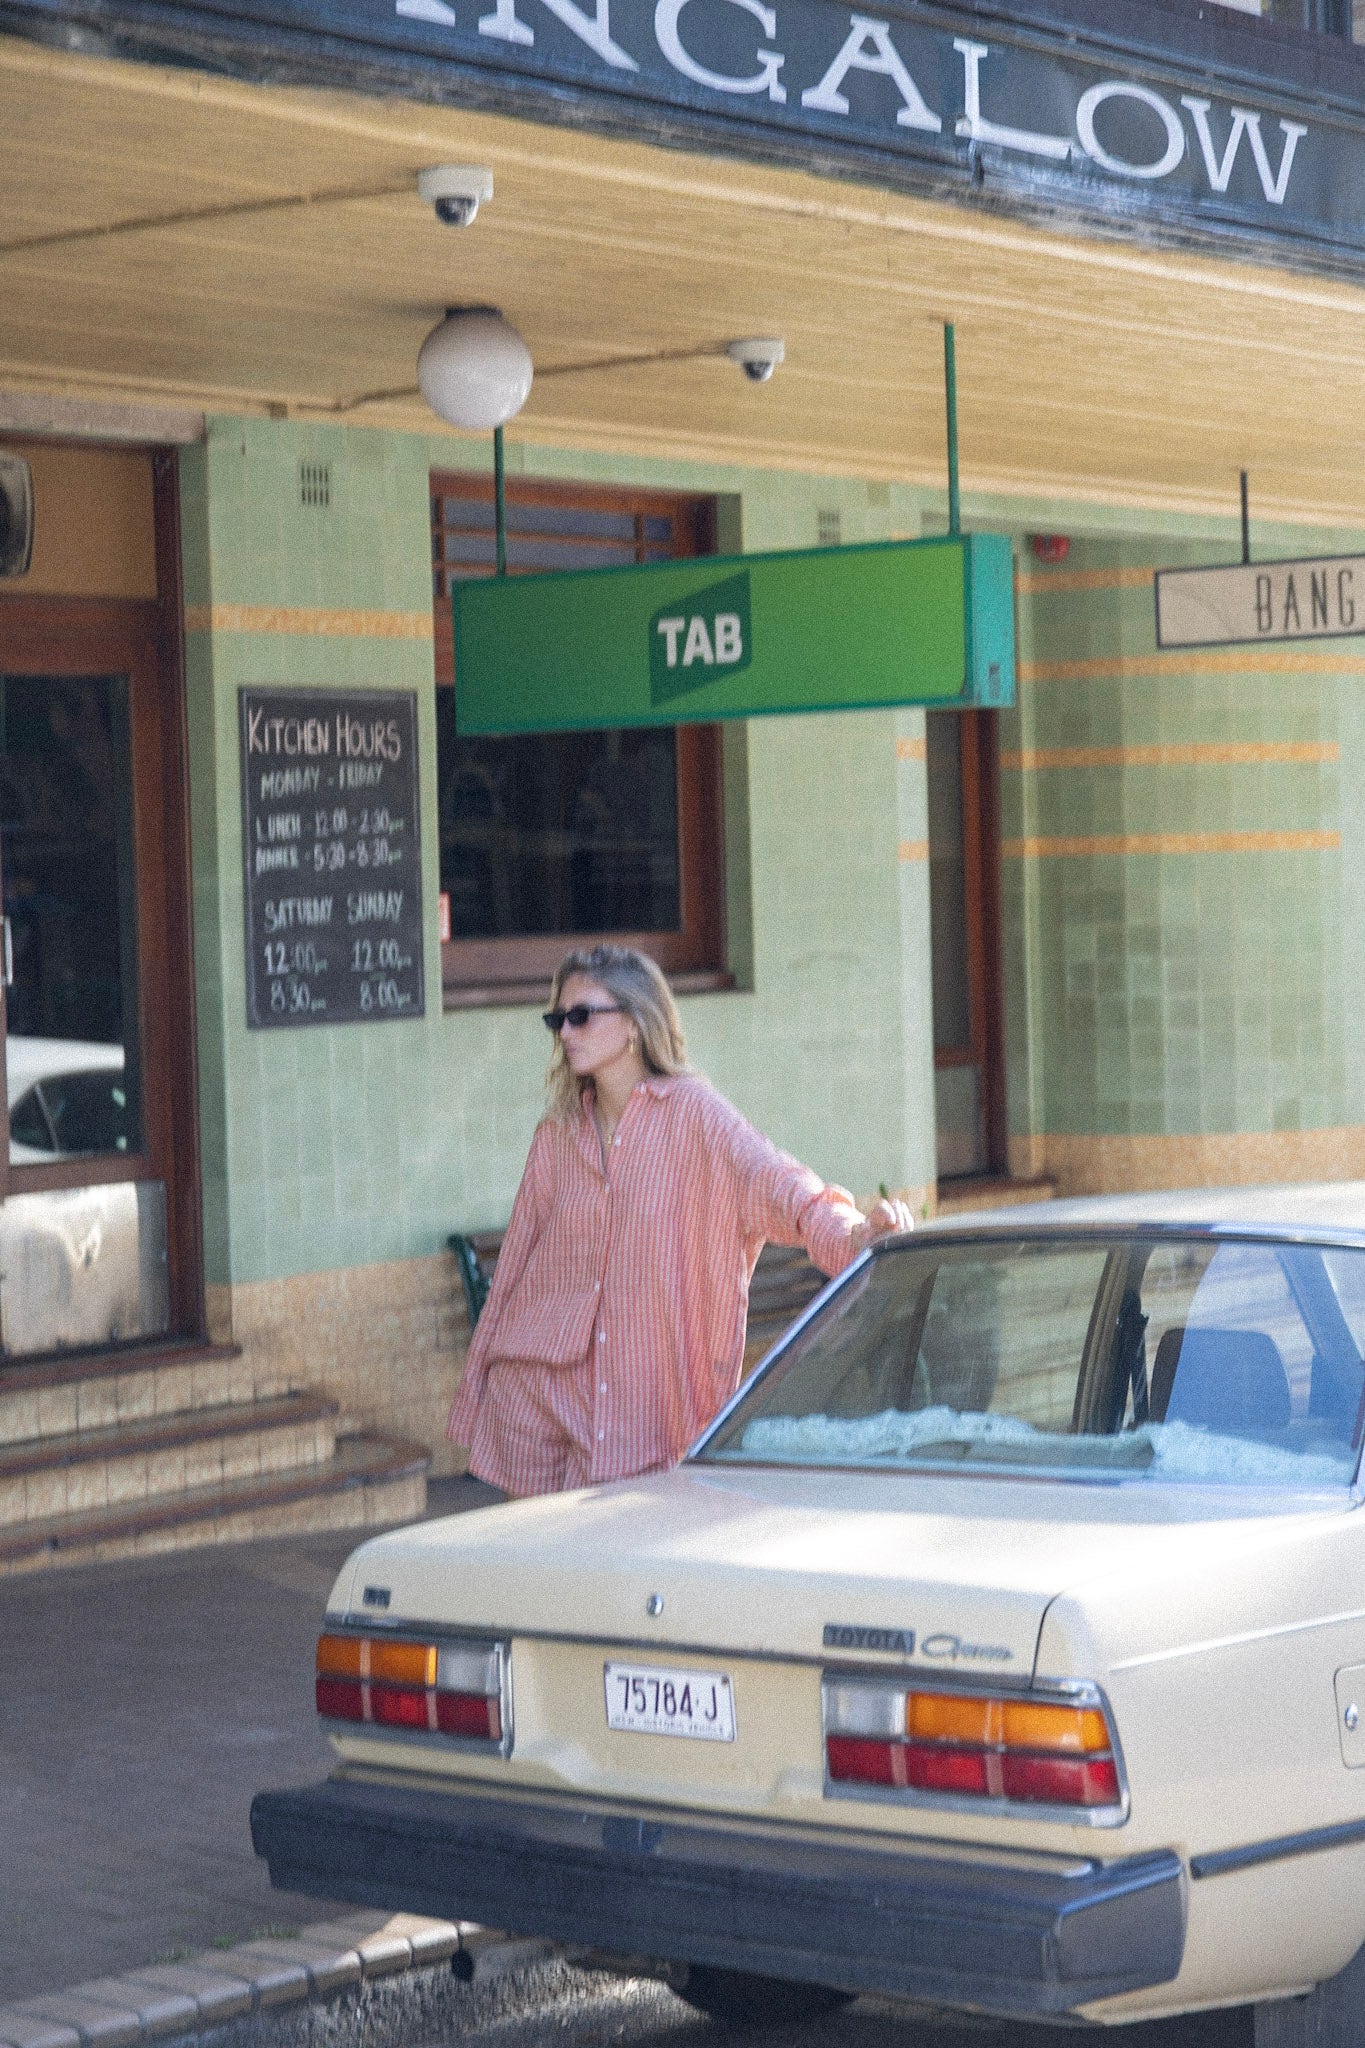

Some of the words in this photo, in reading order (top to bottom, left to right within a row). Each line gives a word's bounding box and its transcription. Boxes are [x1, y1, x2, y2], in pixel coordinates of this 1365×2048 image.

[395, 0, 1309, 204] NGALOW
[1255, 568, 1356, 633] BANG
[657, 612, 743, 668] TAB
[248, 705, 329, 755] KITCHEN
[336, 711, 401, 763] HOURS
[261, 765, 320, 800] MONDAY
[338, 760, 383, 791] FRIDAY
[347, 889, 404, 925] SUNDAY
[826, 1626, 910, 1652] TOYOTA
